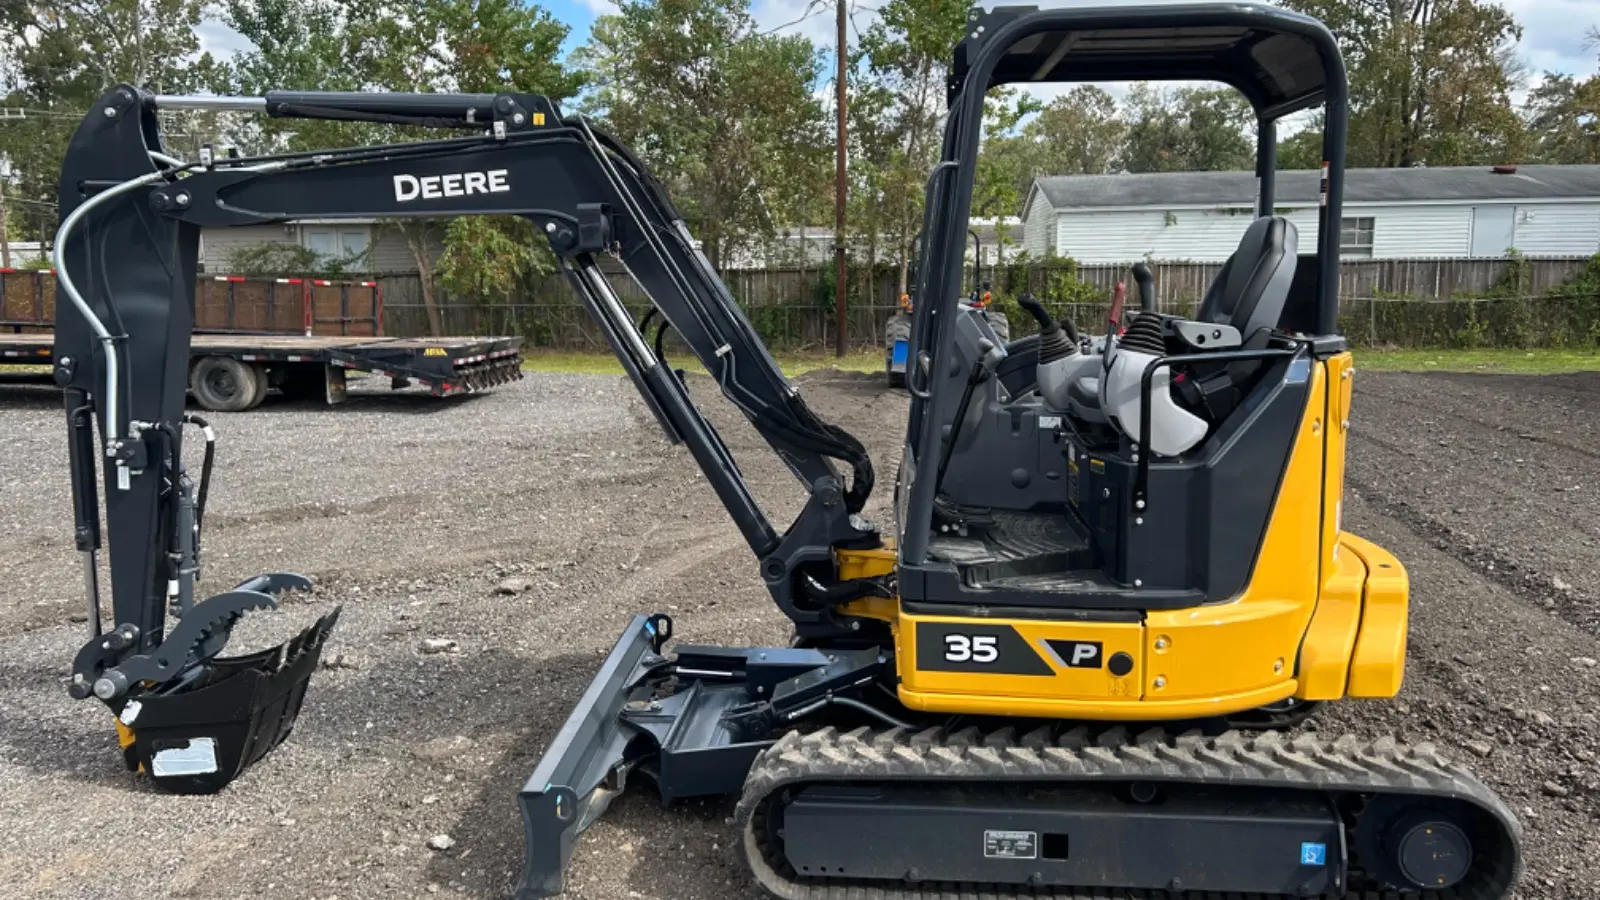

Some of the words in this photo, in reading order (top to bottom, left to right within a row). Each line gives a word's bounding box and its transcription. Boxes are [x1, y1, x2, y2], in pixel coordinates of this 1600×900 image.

[393, 169, 510, 202] DEERE
[945, 634, 998, 663] 35
[1071, 644, 1098, 665] P
